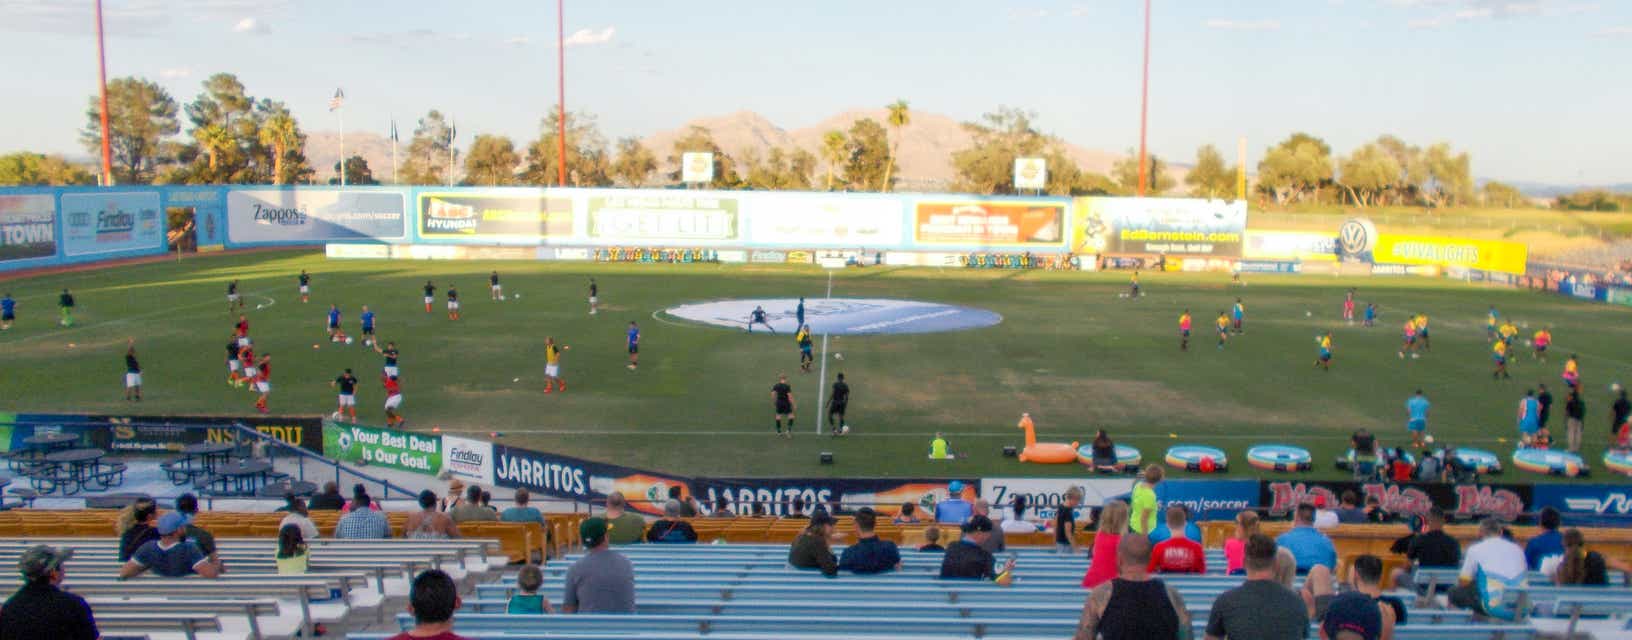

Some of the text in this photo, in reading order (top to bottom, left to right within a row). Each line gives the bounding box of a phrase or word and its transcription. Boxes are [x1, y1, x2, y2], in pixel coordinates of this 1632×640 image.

[97, 208, 134, 230] Findlay
[253, 203, 298, 224] Zappos
[427, 218, 476, 230] HYUNDAI
[4, 223, 53, 244] TOWN
[1121, 229, 1240, 242] EdBernstein.com
[1392, 242, 1478, 264] #VIVALIGHTS
[351, 427, 436, 453] Your Best Deal
[362, 445, 430, 470] Is Our Goal.
[450, 447, 483, 465] Findlay
[497, 453, 585, 495] JARRITOS
[701, 487, 832, 517] JARRITOS
